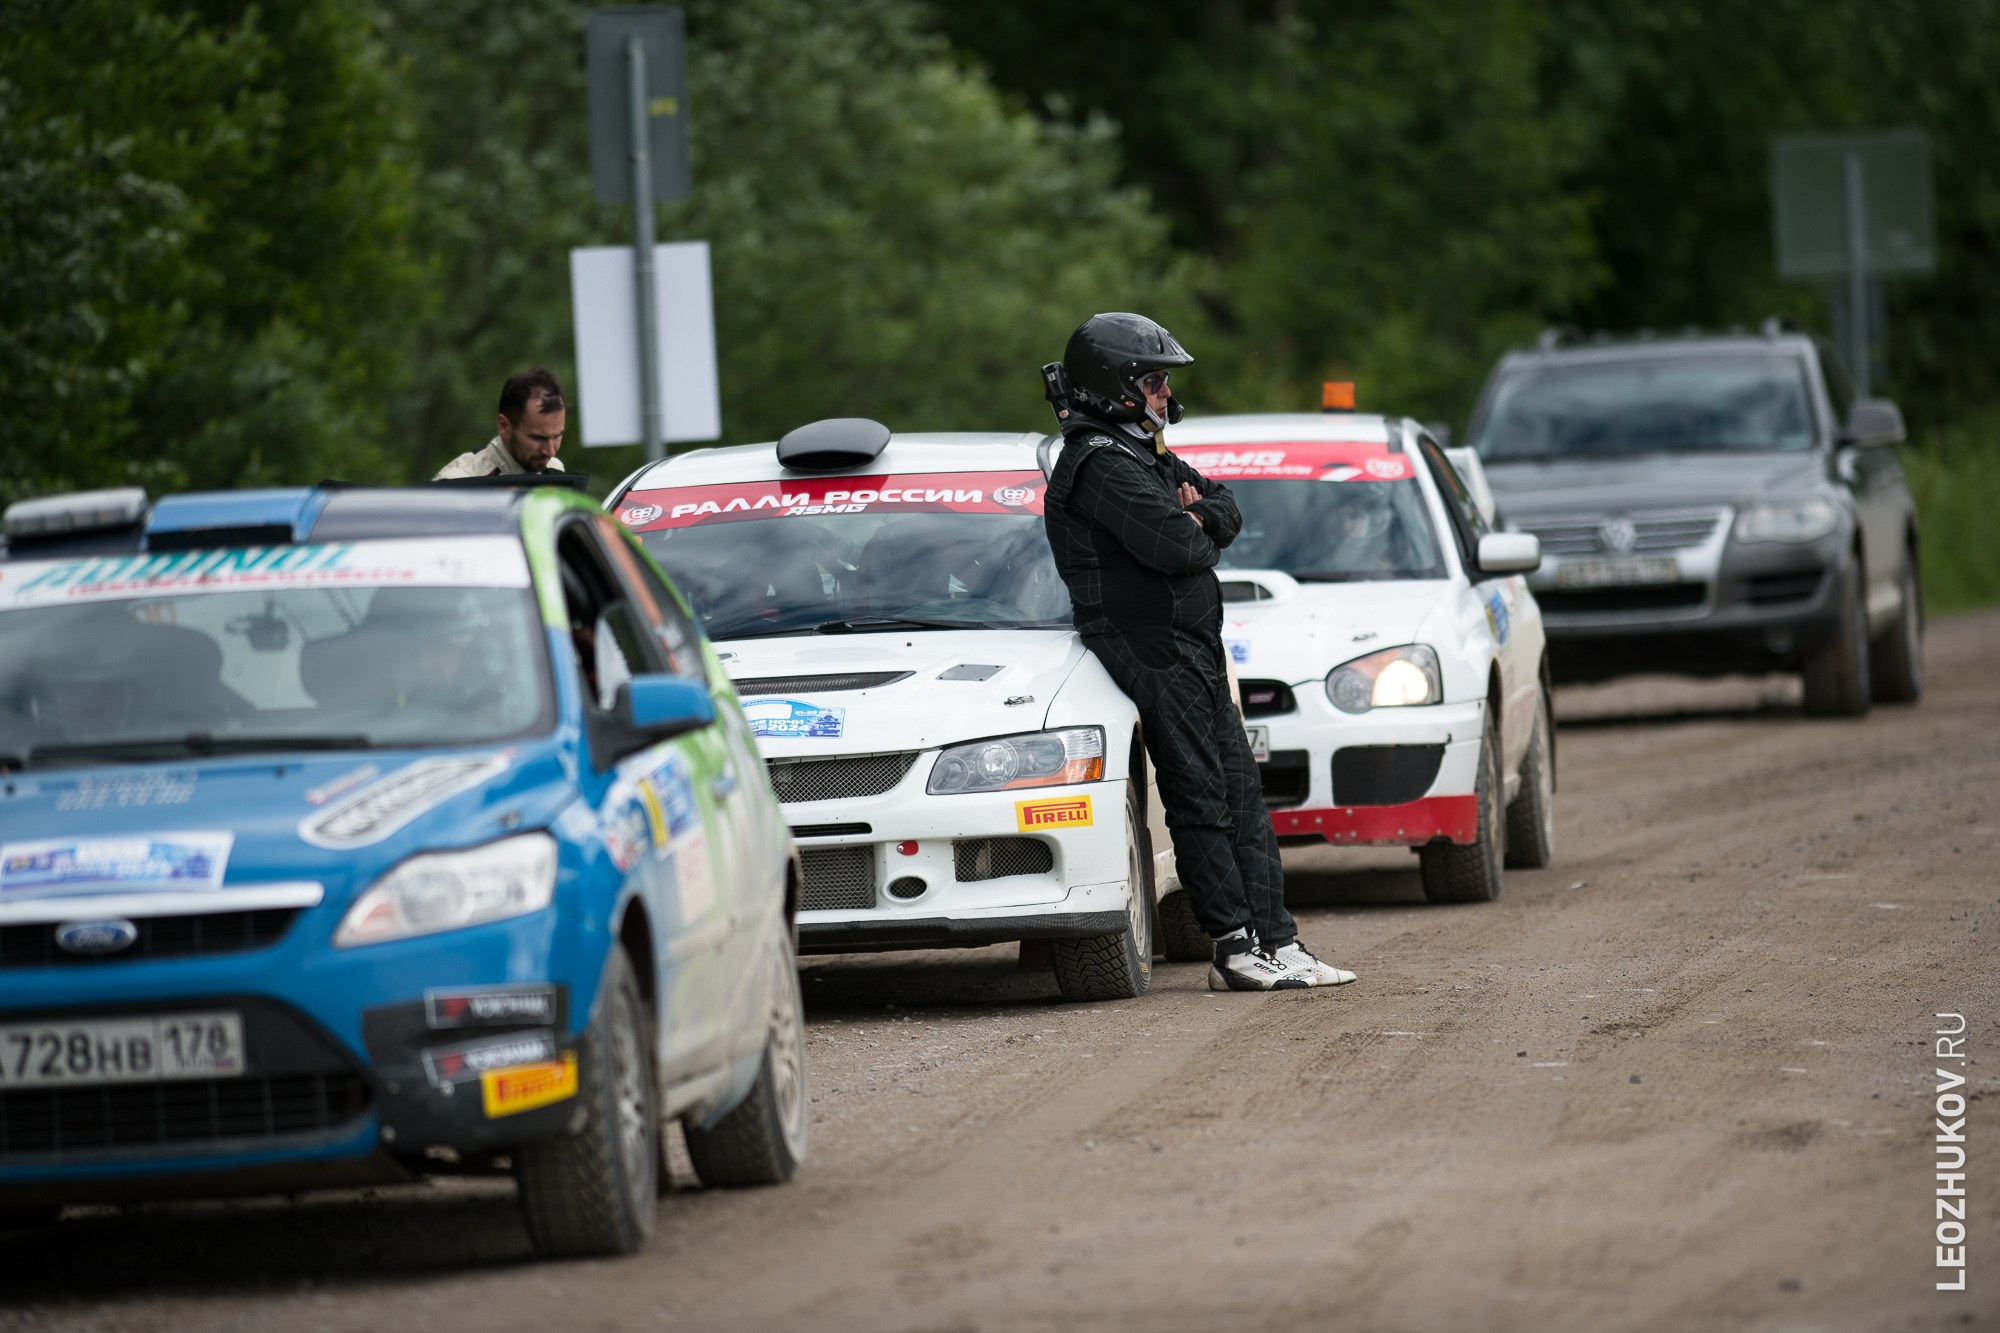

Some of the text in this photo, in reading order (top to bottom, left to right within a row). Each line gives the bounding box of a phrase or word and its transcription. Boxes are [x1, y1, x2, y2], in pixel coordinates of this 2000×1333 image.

[671, 489, 983, 519] РАЛЛИ РОССИИ
[767, 724, 811, 732] 2024
[1023, 802, 1087, 825] PIRELLI
